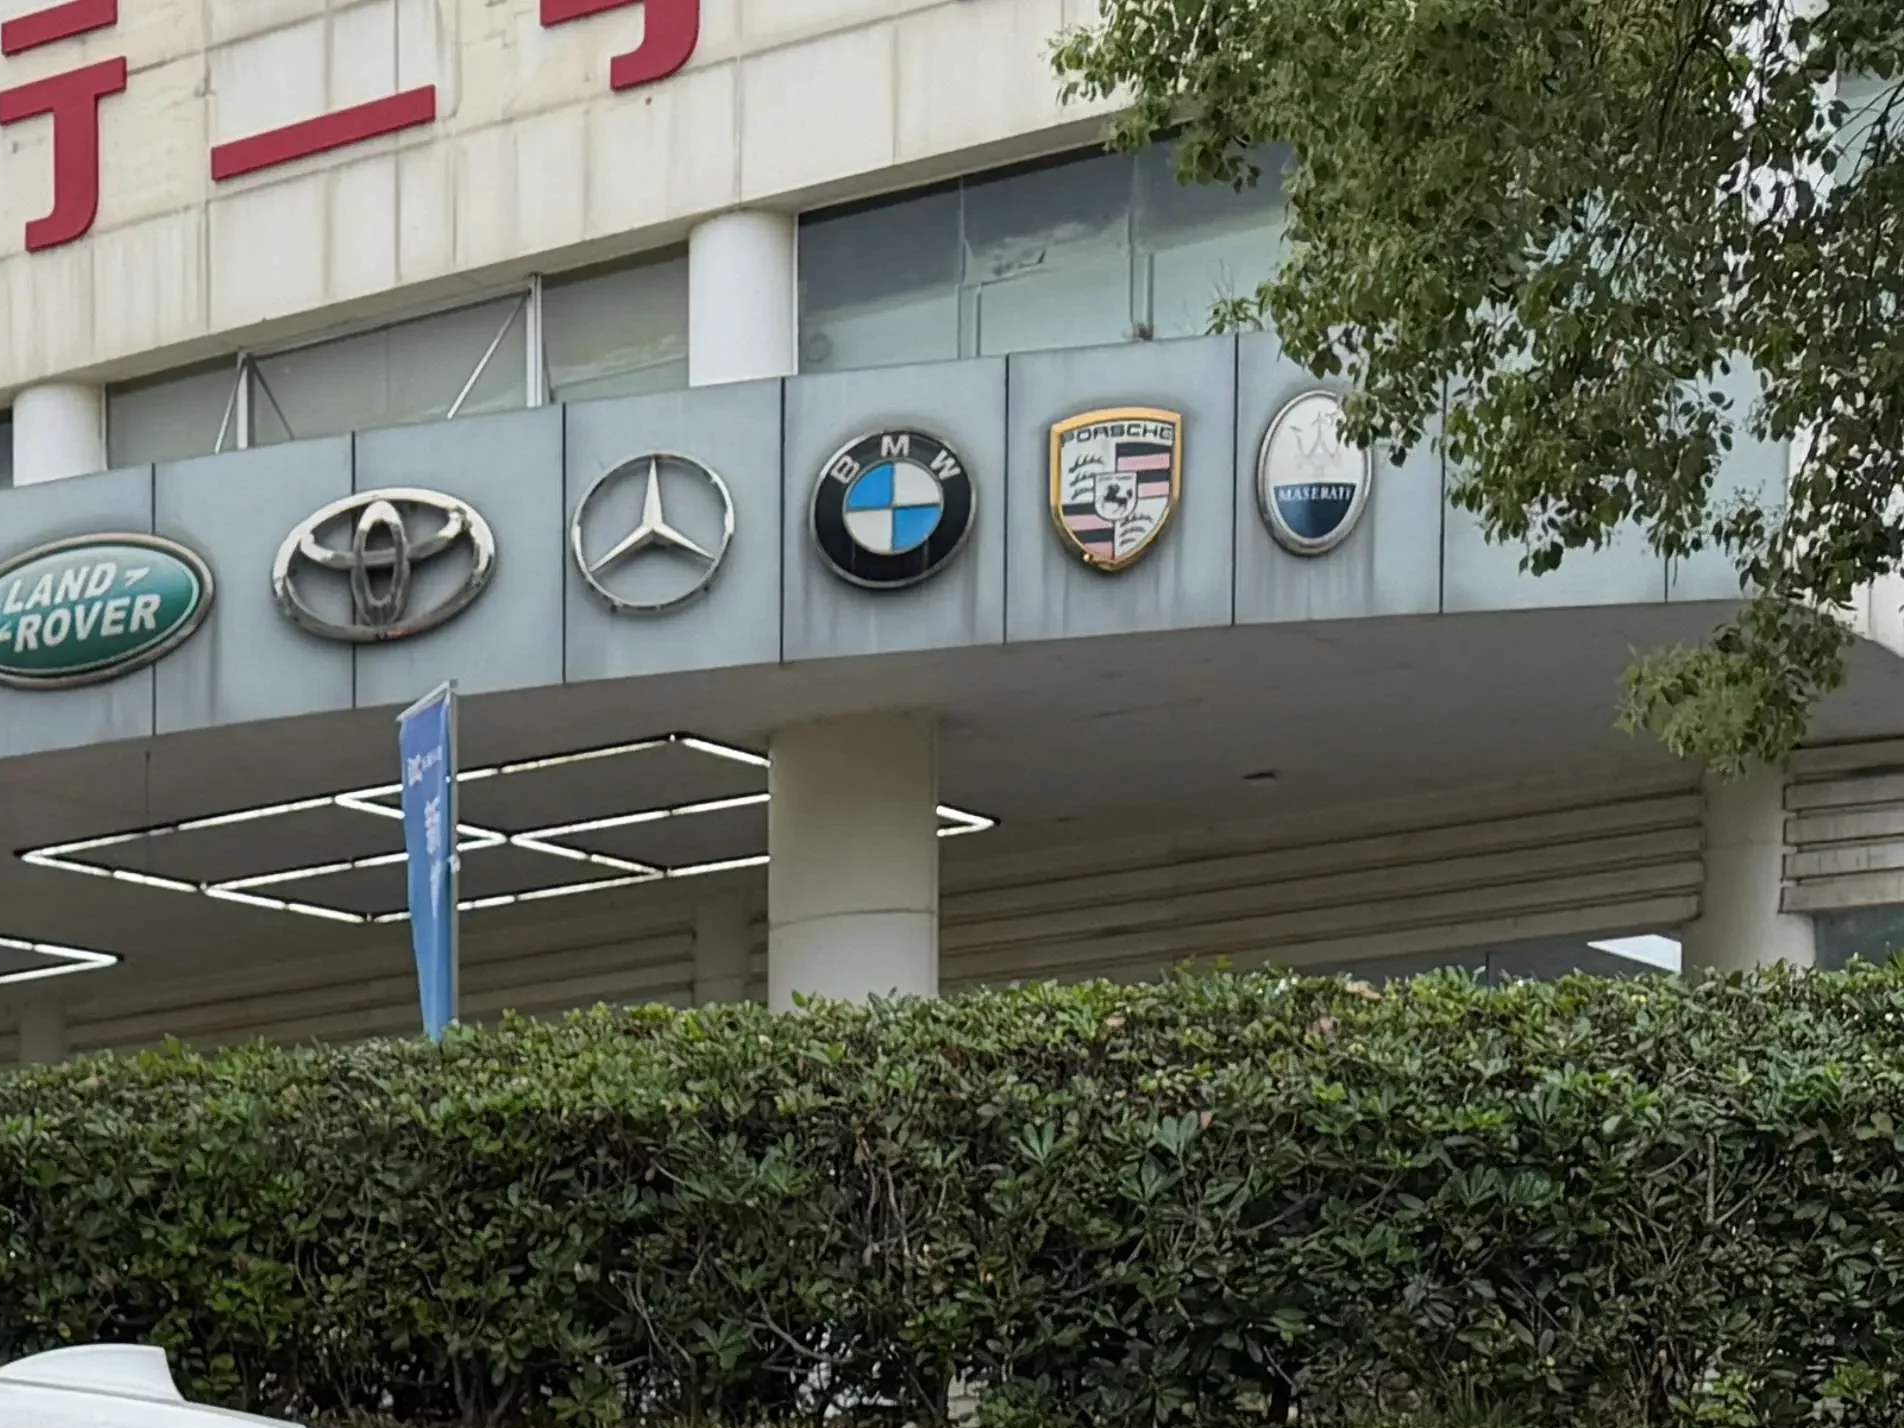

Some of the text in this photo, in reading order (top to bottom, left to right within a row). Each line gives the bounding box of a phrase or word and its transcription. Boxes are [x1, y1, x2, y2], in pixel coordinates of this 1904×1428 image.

[830, 433, 962, 485] BMW
[1063, 422, 1176, 444] PORSCHE
[1278, 486, 1352, 501] MASERATI
[2, 562, 117, 616] LAND
[13, 593, 161, 653] ROVER
